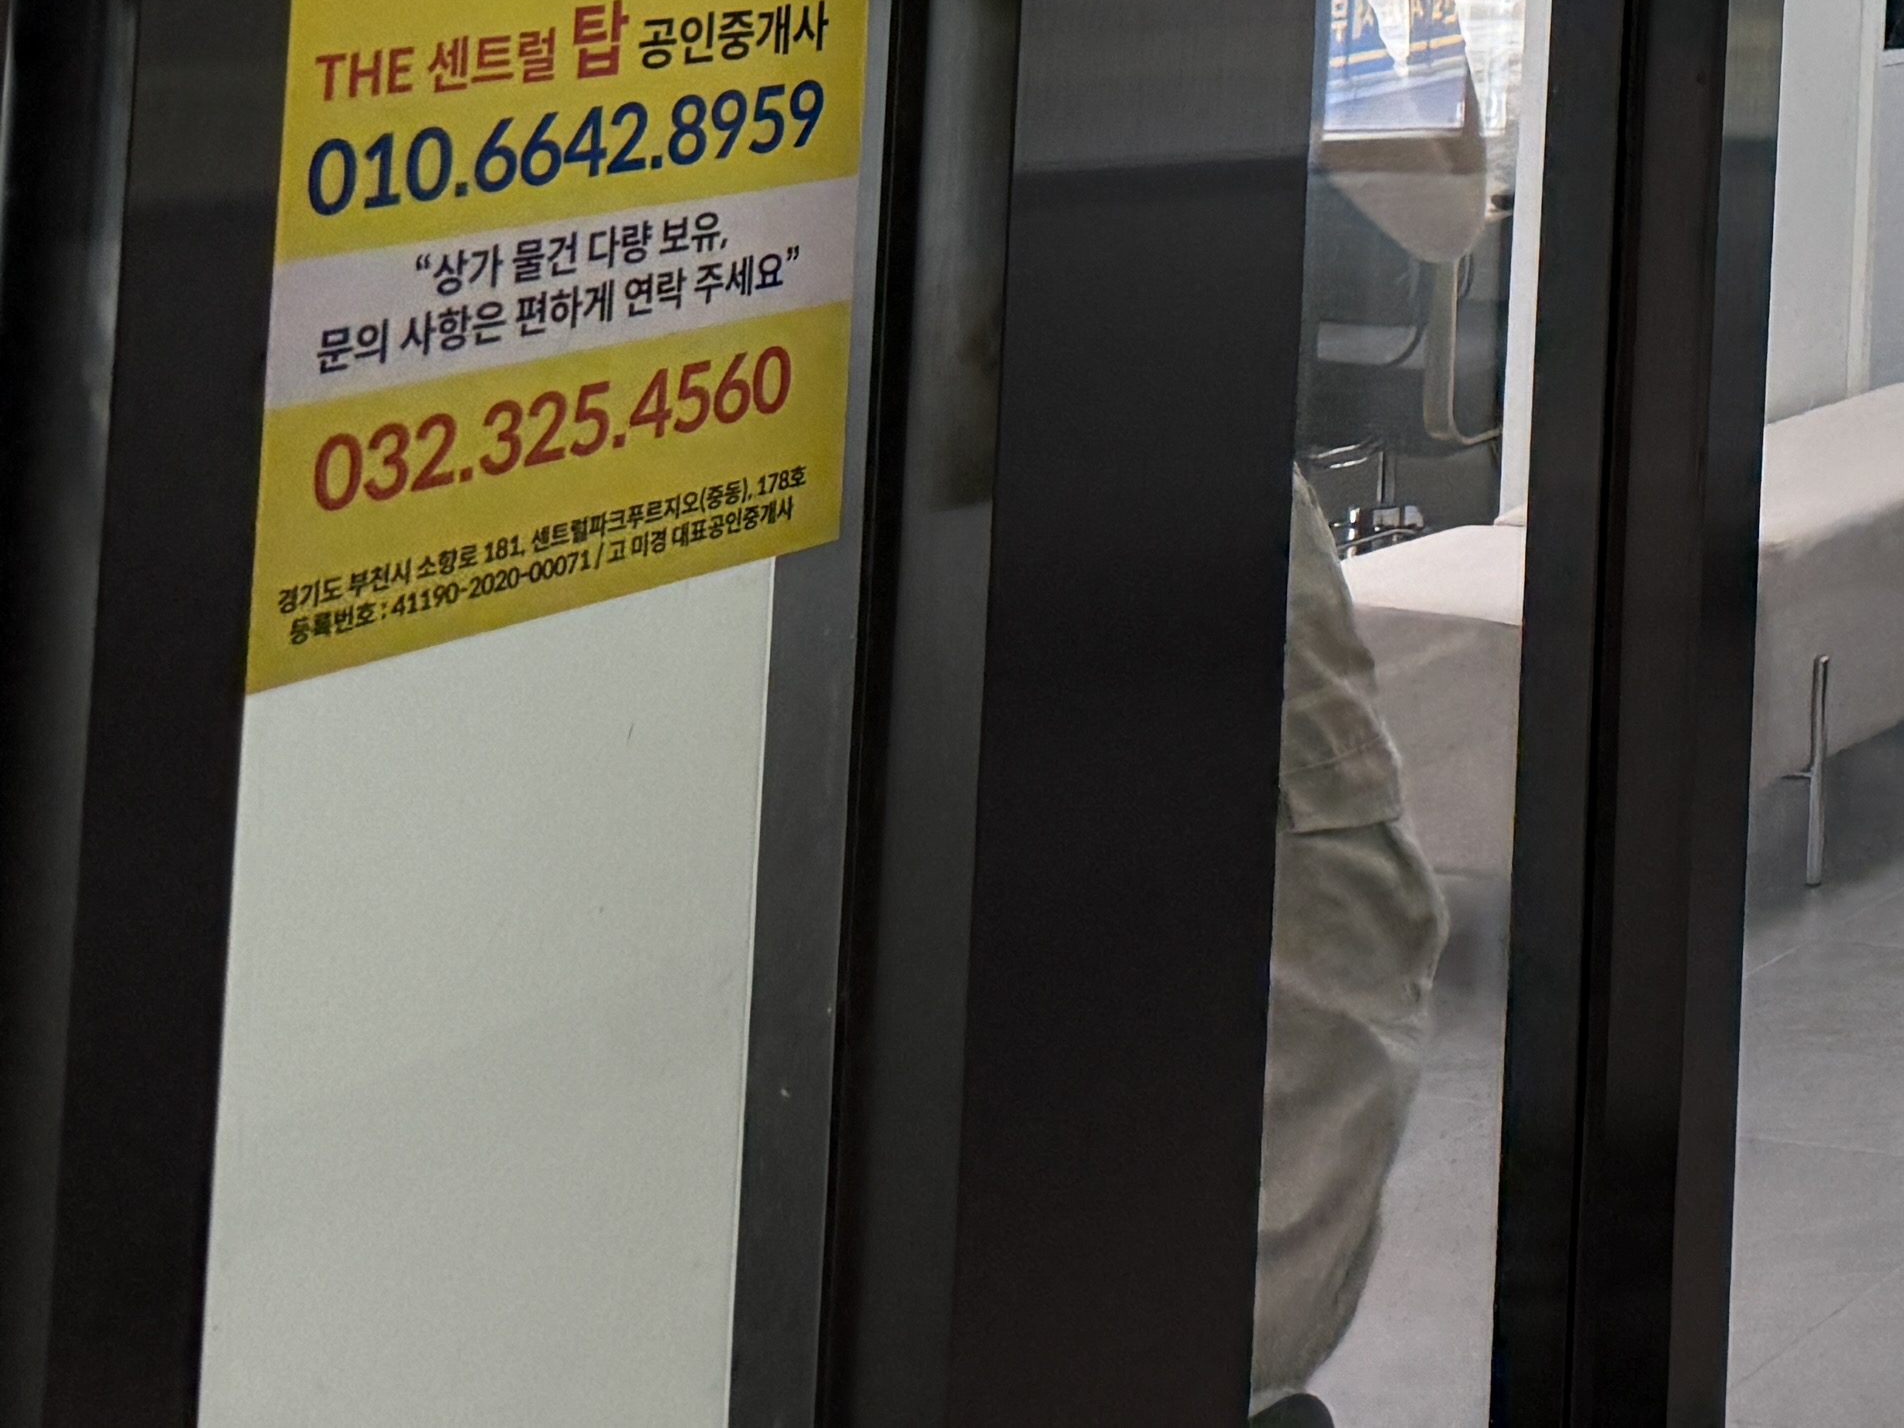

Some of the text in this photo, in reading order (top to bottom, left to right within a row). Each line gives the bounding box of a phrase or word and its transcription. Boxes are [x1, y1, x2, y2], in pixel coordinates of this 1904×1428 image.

[315, 0, 830, 102] THE 센트럴 탑 공인중개사
[307, 79, 827, 217] 010.6642.8959
[510, 233, 580, 283] 물건
[587, 220, 654, 273] 다량
[659, 209, 730, 257] 보유,
[316, 319, 390, 375] 문의
[399, 299, 507, 357] 사항은
[513, 282, 615, 339] 편하게
[624, 269, 688, 321] 연락
[312, 344, 793, 513] 032.325.4560
[277, 577, 343, 616] 경기도
[347, 558, 413, 593] 부천시
[416, 543, 479, 578] 소향로
[482, 534, 526, 563] 181,
[756, 465, 808, 499] 178호
[671, 496, 795, 548] 대표공인중개사
